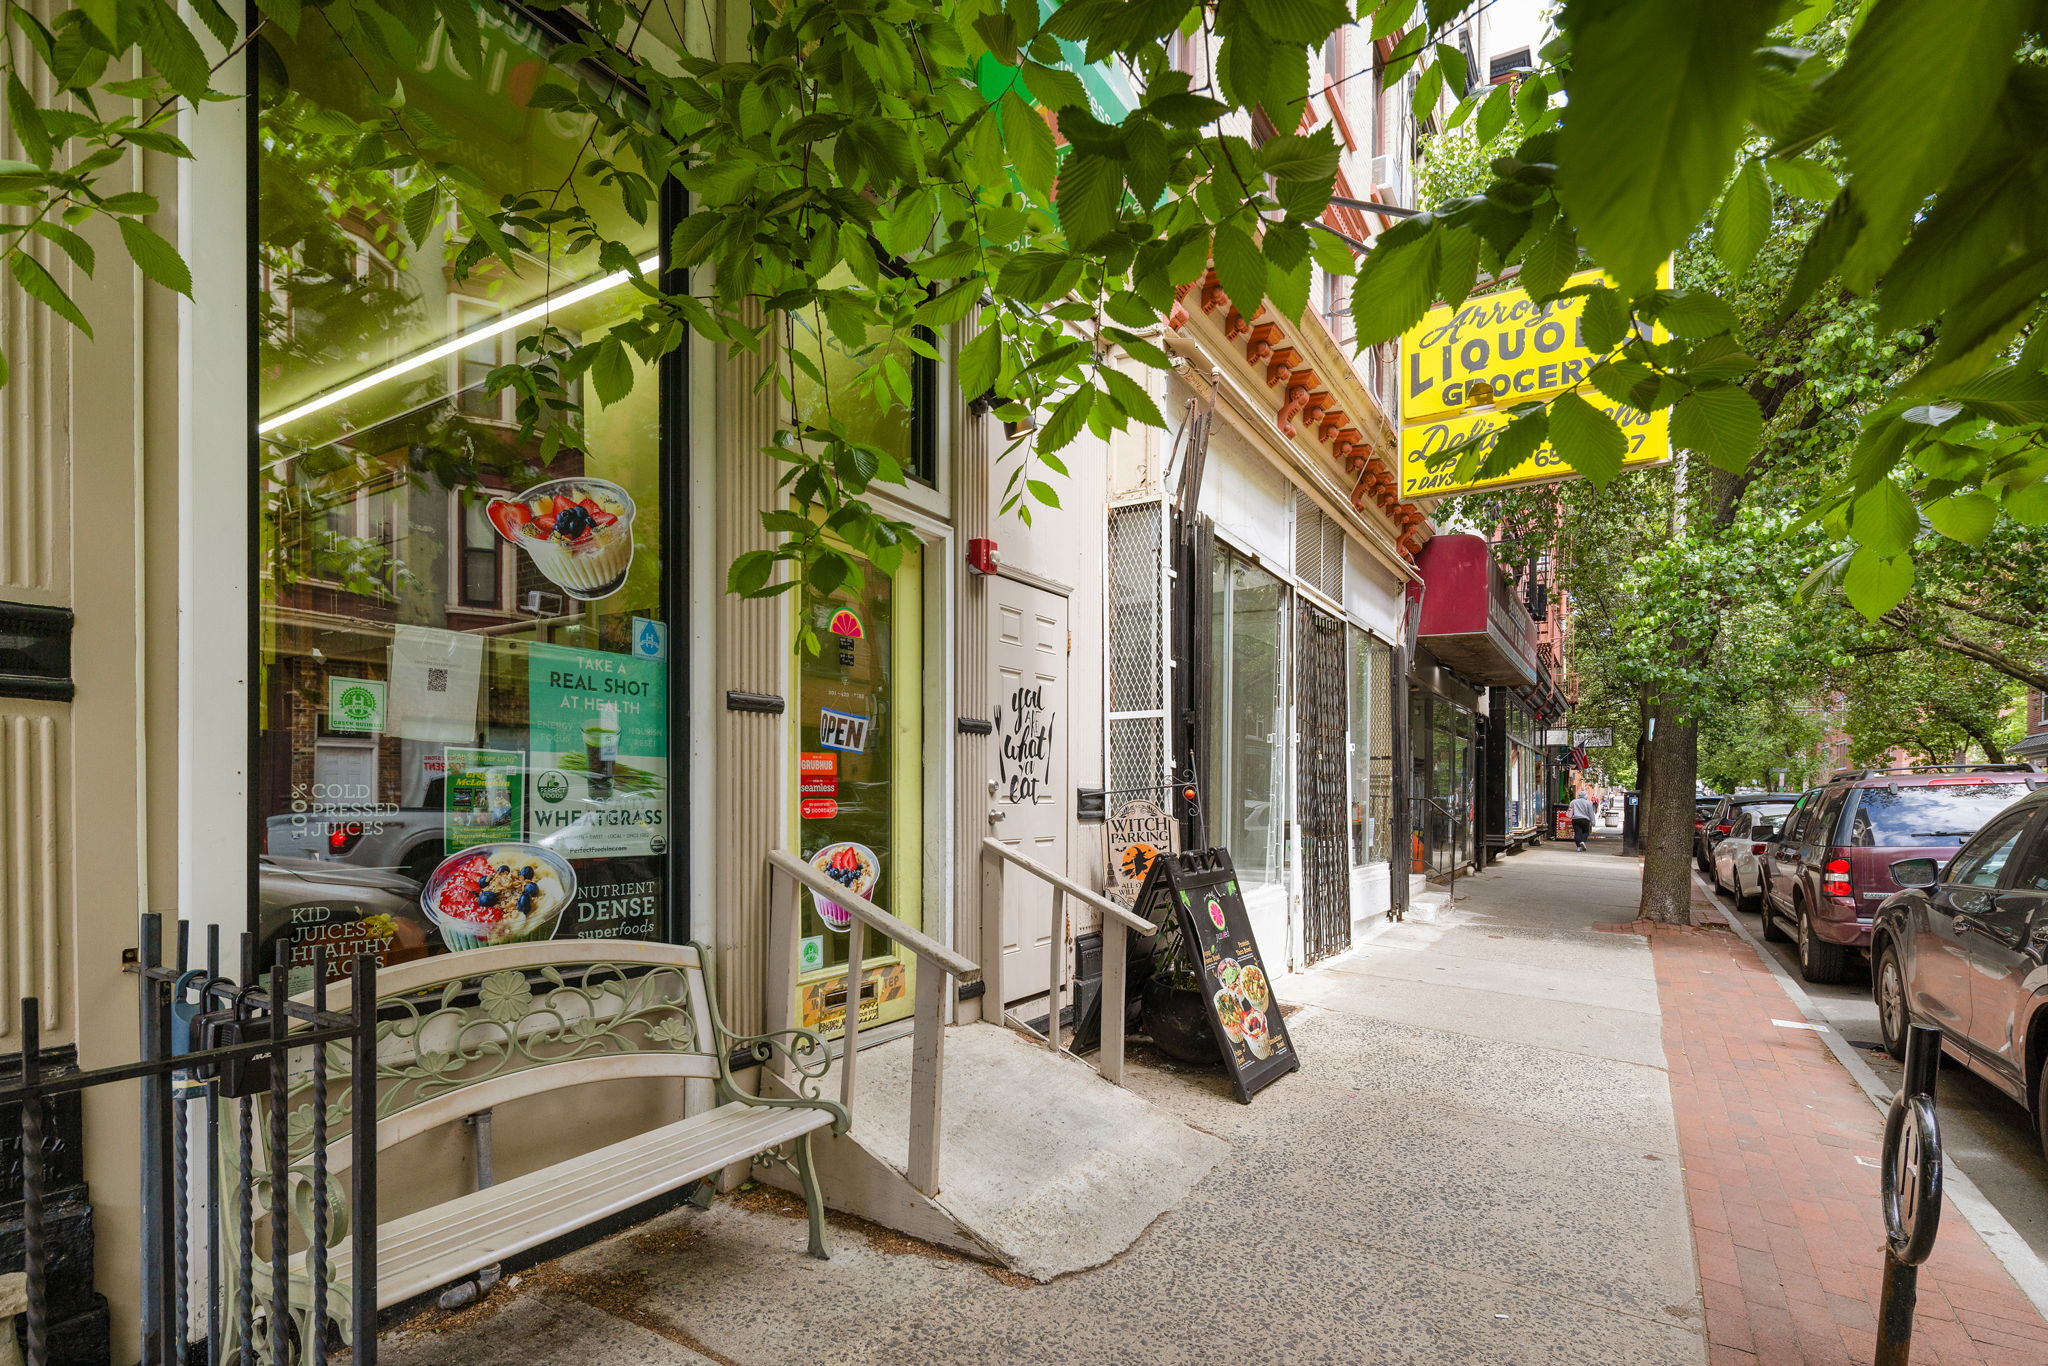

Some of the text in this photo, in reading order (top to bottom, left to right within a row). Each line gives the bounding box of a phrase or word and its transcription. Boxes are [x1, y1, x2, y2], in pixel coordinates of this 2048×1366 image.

[1410, 308, 1653, 399] LIQUO
[1418, 473, 1455, 490] DAYS
[577, 656, 626, 674] TAKE A
[550, 671, 650, 697] REAL SHOT
[560, 695, 640, 715] AT HEALTH
[821, 713, 864, 748] OPEN
[1003, 724, 1047, 762] what
[800, 760, 834, 771] GRUBHUB
[311, 783, 370, 799] COLD
[801, 782, 835, 793] seamless
[291, 783, 308, 837] 100%
[310, 802, 400, 818] PRESSED
[311, 821, 384, 837] JUICES
[1111, 816, 1168, 833] WITCH
[1111, 830, 1169, 844] PARKING
[577, 881, 655, 900] NUTRIENT
[1119, 888, 1135, 897] WILL
[291, 906, 331, 924] KID
[577, 896, 655, 923] DENSE
[291, 921, 382, 943] JUICES &
[577, 918, 655, 939] superfoods
[883, 975, 899, 989] TEP
